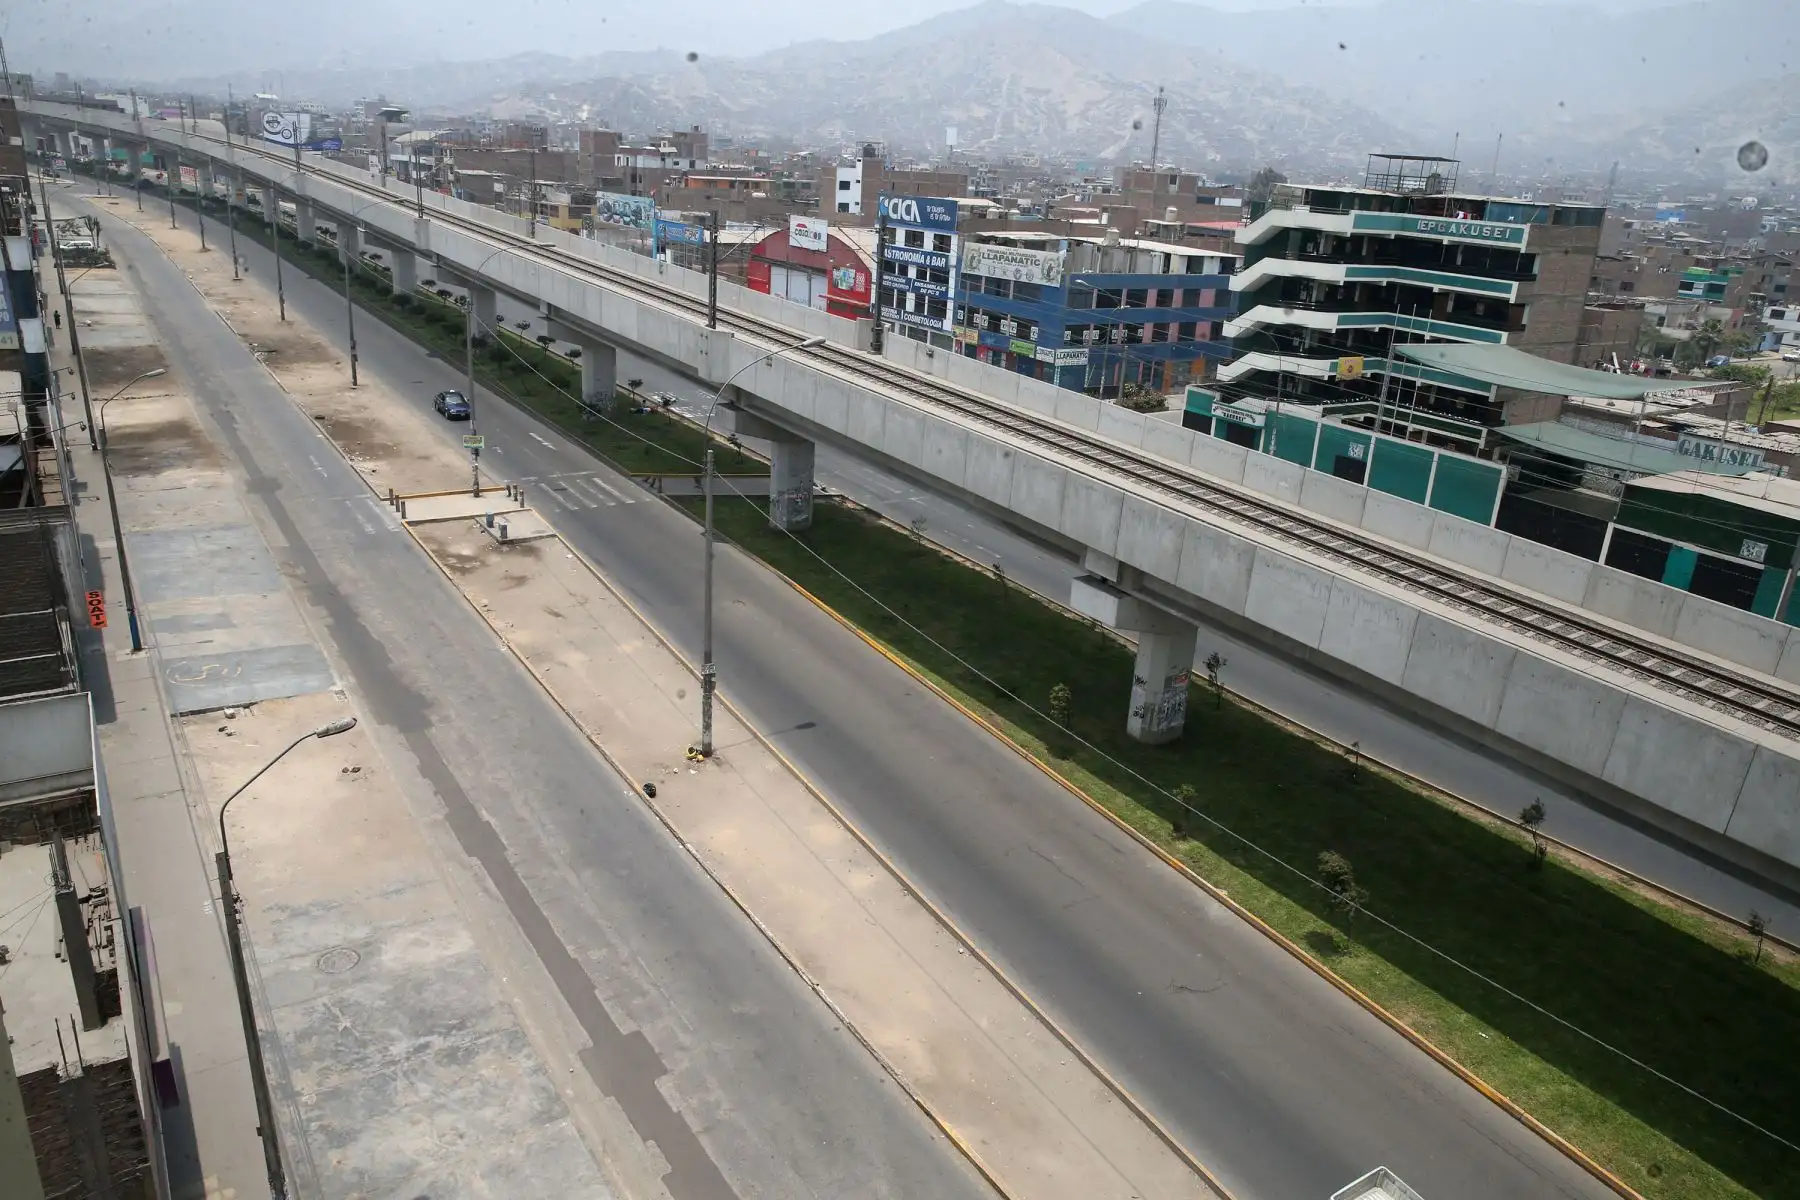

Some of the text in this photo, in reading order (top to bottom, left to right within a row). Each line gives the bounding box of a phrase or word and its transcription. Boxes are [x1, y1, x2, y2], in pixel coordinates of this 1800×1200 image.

[1438, 222, 1511, 239] GAKUSEI
[884, 249, 946, 268] ASTRONOMÍA & BAR
[982, 252, 1040, 266] LLAPANATIC
[88, 591, 105, 620] SOAT
